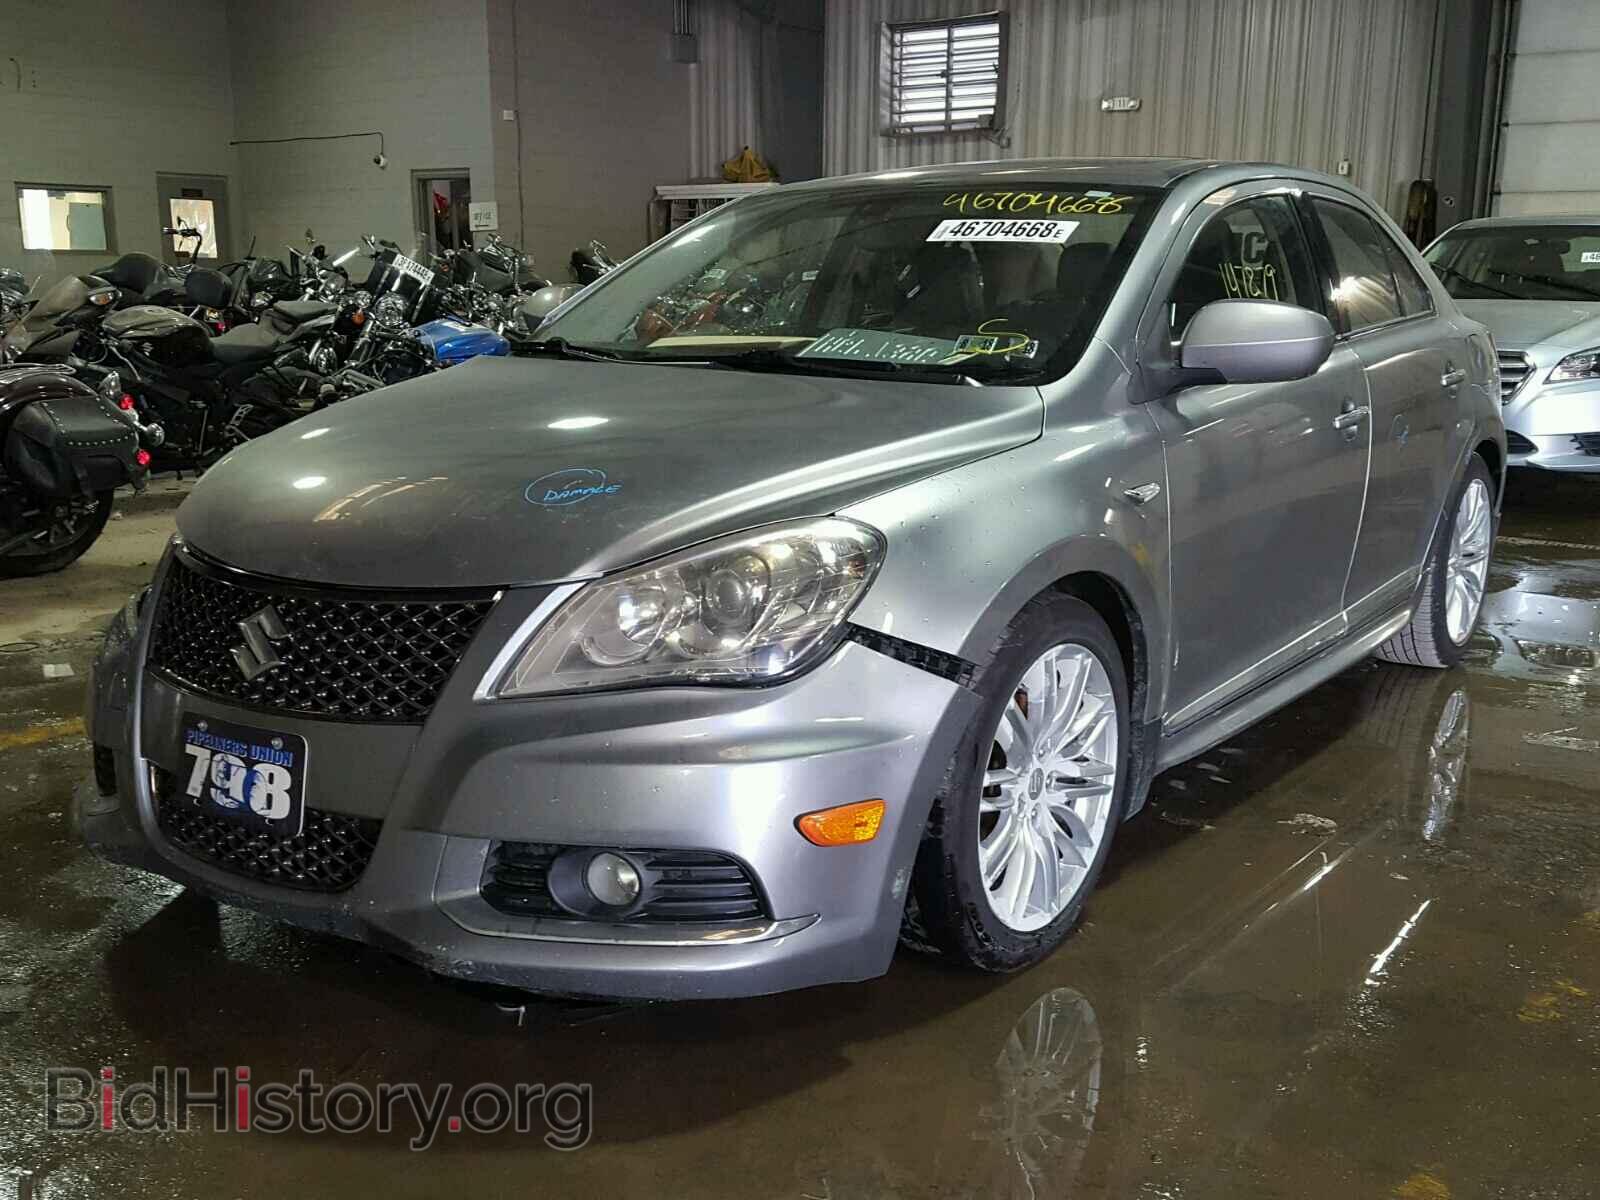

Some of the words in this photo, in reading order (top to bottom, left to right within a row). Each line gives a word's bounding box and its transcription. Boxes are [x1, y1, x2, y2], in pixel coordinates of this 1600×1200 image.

[943, 192, 1133, 214] 46704668
[950, 221, 1058, 238] 46704668
[251, 744, 293, 767] UNION
[185, 743, 292, 819] 798
